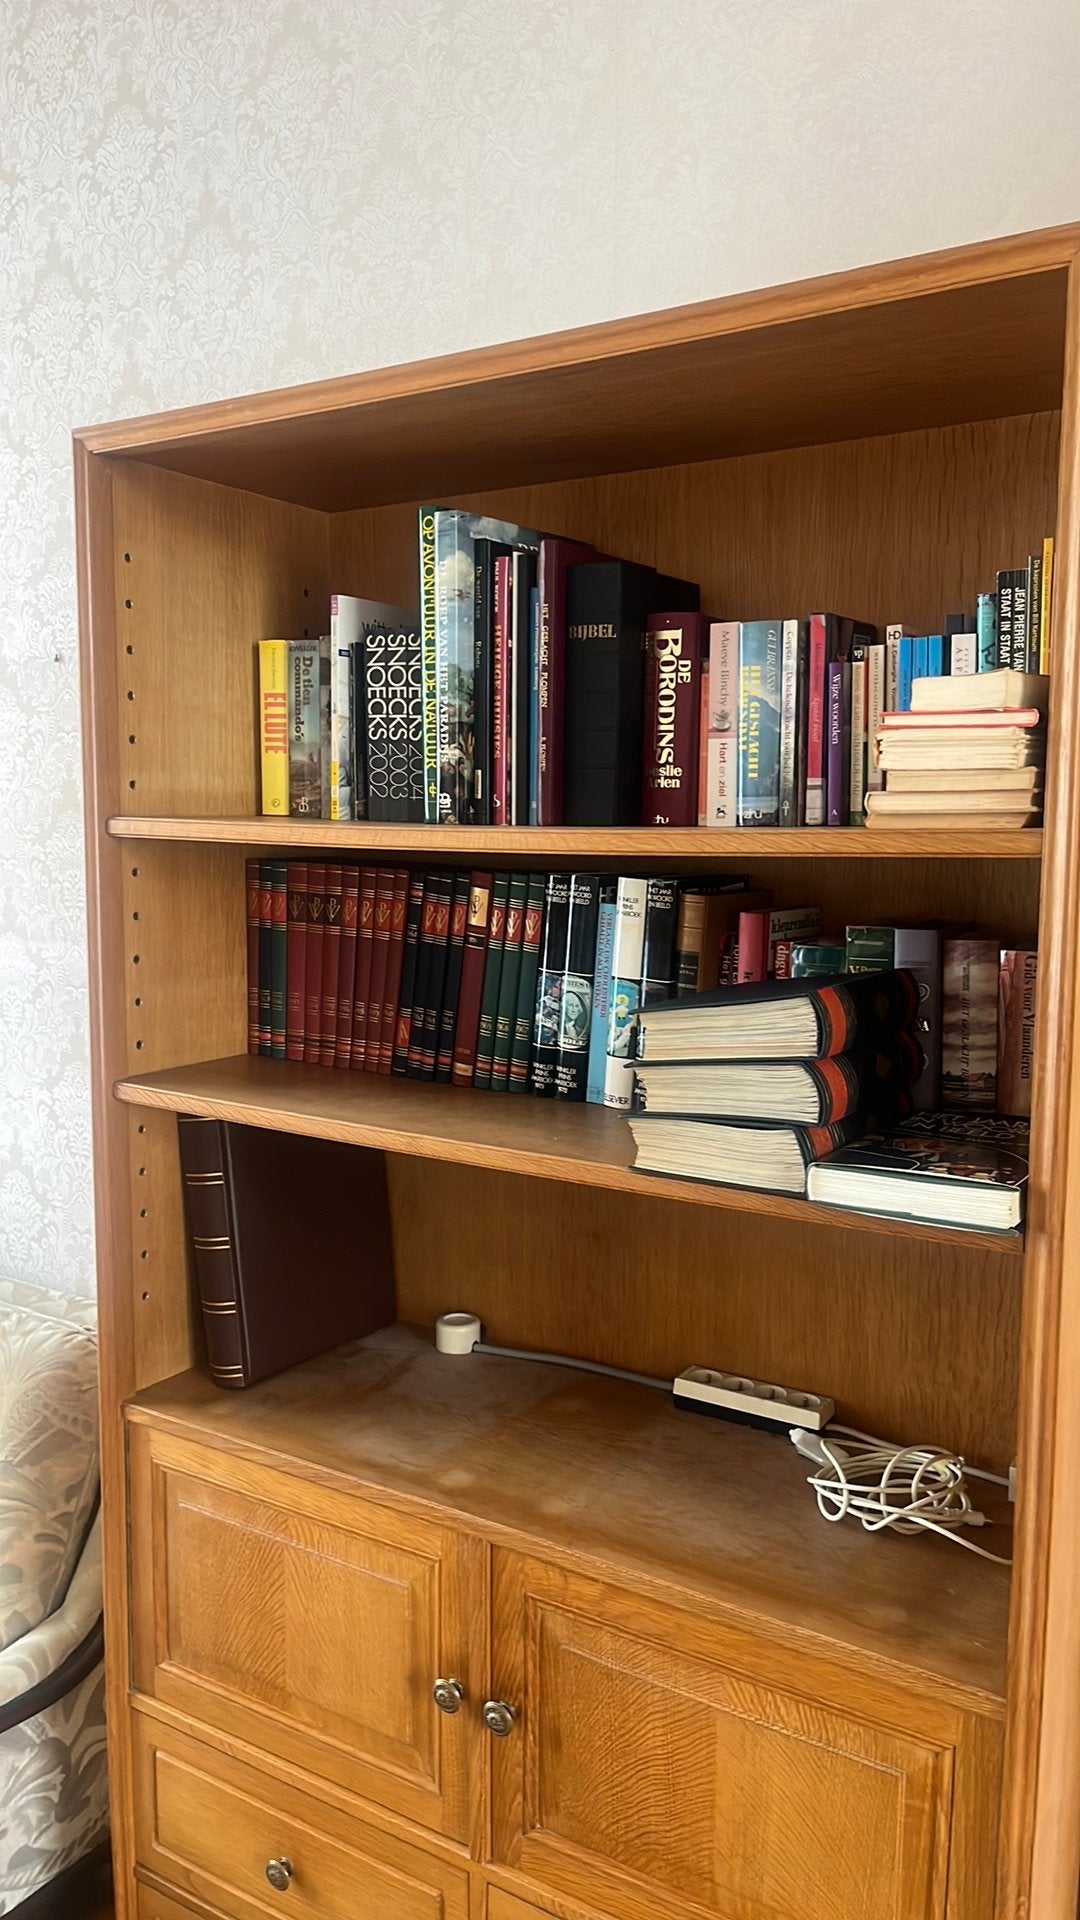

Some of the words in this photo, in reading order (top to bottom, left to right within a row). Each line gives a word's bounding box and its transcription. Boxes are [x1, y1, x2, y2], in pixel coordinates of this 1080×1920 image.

[422, 515, 435, 540] OP
[1033, 559, 1040, 569] De
[423, 541, 436, 641] AVONTUUR
[438, 585, 448, 625] ROEP
[1000, 588, 1012, 622] STAAT
[1014, 587, 1026, 613] JEAN
[438, 630, 449, 658] VAN
[568, 624, 617, 641] BIJBEL
[1000, 625, 1010, 634] IN
[1014, 615, 1025, 649] PIERRE
[424, 646, 436, 664] IN
[541, 626, 549, 666] GESLACHT
[721, 630, 731, 668] Maeve
[1000, 635, 1010, 664] STAAT
[1014, 650, 1024, 672] VAN
[302, 655, 314, 677] De
[677, 659, 692, 684] DE
[303, 678, 314, 706] tien
[366, 634, 389, 741] SNOECKS
[387, 633, 408, 741] SNOECKS
[425, 671, 437, 695] DE
[540, 672, 548, 708] PLOMPEN
[654, 628, 683, 764] BORODINS
[719, 671, 730, 707] Binchy
[830, 673, 841, 700] Wijze
[264, 692, 287, 711] EL
[293, 657, 305, 742] commando's
[264, 713, 288, 754] LUTE
[426, 699, 437, 769] NATUUR
[831, 702, 841, 745] woorden
[718, 742, 728, 764] Hart
[747, 700, 761, 779] GESLACHT
[368, 743, 389, 799] 2002
[389, 743, 409, 800] 2003
[718, 766, 726, 778] en
[717, 780, 727, 797] ziel
[1023, 954, 1038, 984] Gids
[1022, 986, 1033, 1012] voor
[1020, 1013, 1036, 1080] Vlaanderen
